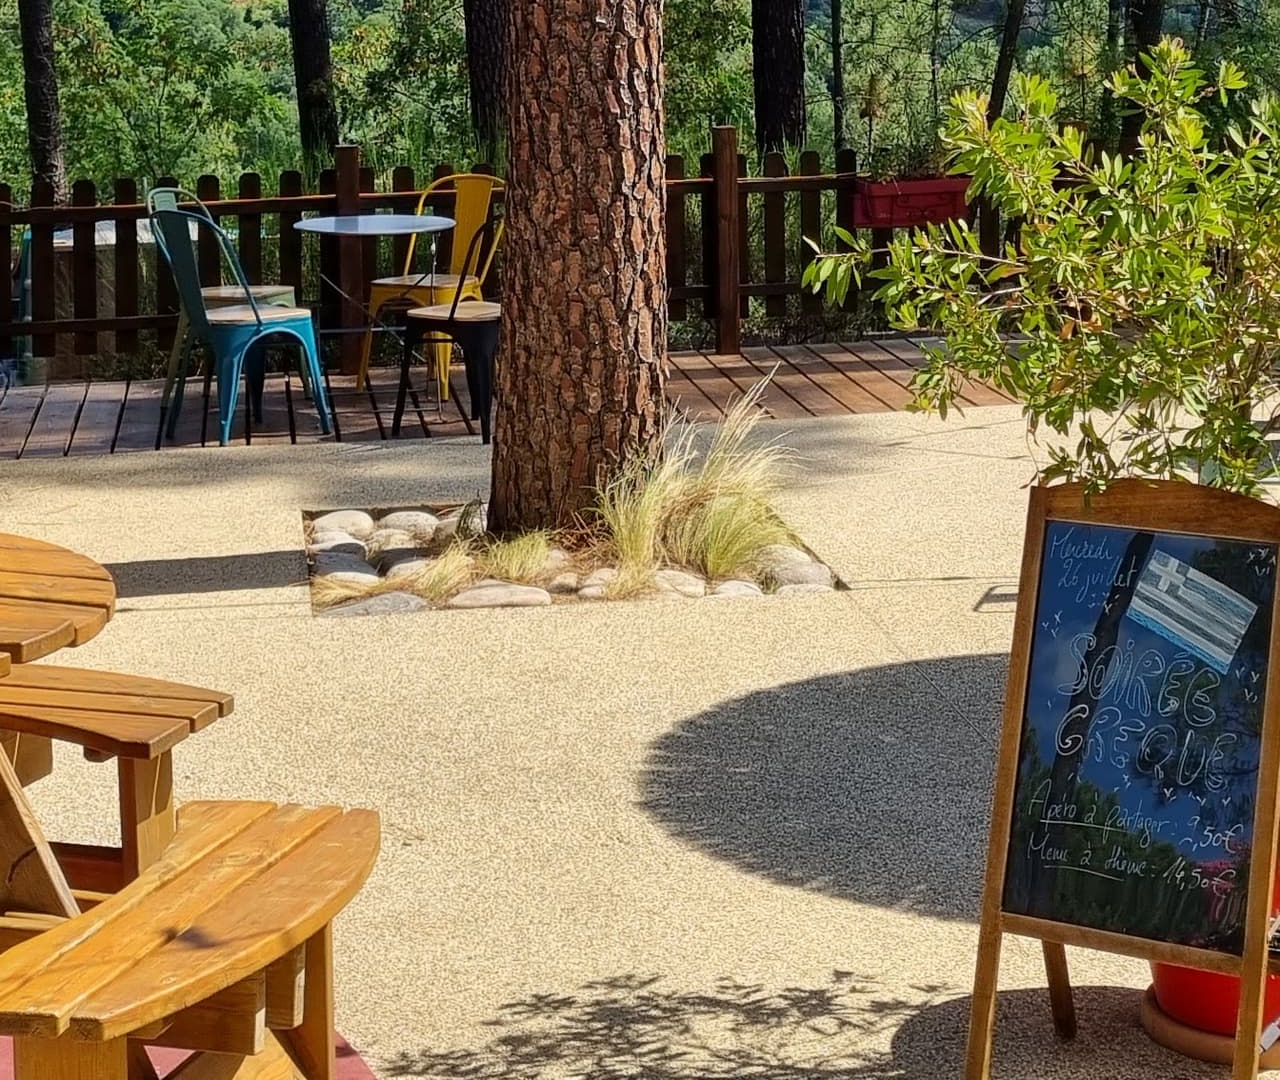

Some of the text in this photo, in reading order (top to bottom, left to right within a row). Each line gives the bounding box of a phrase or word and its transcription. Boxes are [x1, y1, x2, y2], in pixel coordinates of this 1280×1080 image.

[1058, 554, 1138, 604] 26 juillet
[1057, 633, 1221, 727] SOIRÉE
[1028, 778, 1077, 832] Apéro
